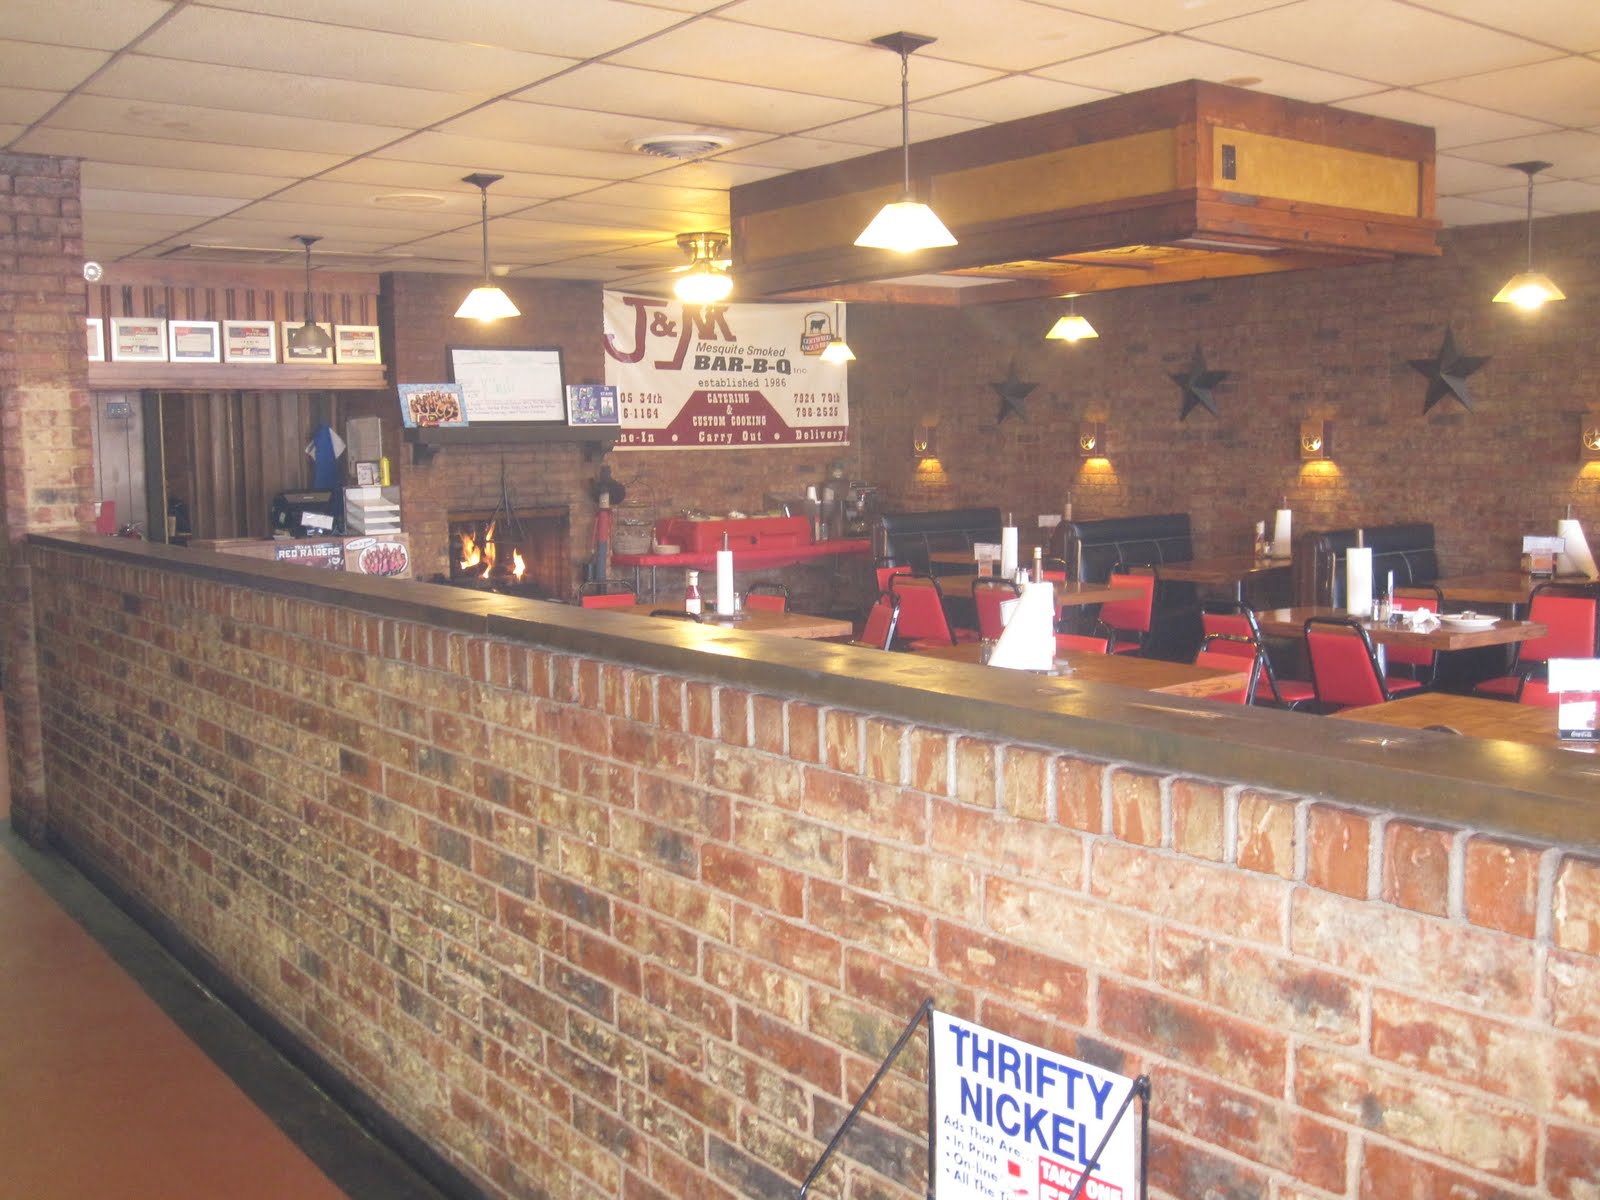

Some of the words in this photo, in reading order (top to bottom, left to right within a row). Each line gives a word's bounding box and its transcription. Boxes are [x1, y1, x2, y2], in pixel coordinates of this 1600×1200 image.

[696, 342, 744, 356] Mesquite
[747, 346, 786, 357] Smoked
[694, 355, 791, 376] BAR-B-Q
[698, 378, 759, 388] established
[765, 378, 786, 388] 1986
[620, 392, 633, 404] 05
[640, 392, 663, 404] 34th
[707, 393, 750, 404] CATERING
[623, 407, 659, 419] 6-1164
[726, 404, 733, 415] &
[692, 415, 726, 427] CUSTOM
[731, 415, 767, 427] COOKING
[615, 431, 655, 443] ne-In
[698, 431, 733, 444] Carry
[742, 430, 762, 442] Out
[795, 429, 844, 441] Delivery
[278, 549, 298, 559] RED
[300, 547, 340, 557] RAIDERS
[948, 1024, 1114, 1121] THRIFTY
[960, 1076, 1101, 1171] NICKEL
[943, 1114, 964, 1133] Ads
[969, 1125, 994, 1146] That
[953, 1135, 964, 1149] In
[968, 1142, 998, 1165] Print
[953, 1170, 969, 1187] All
[975, 1178, 996, 1198] The
